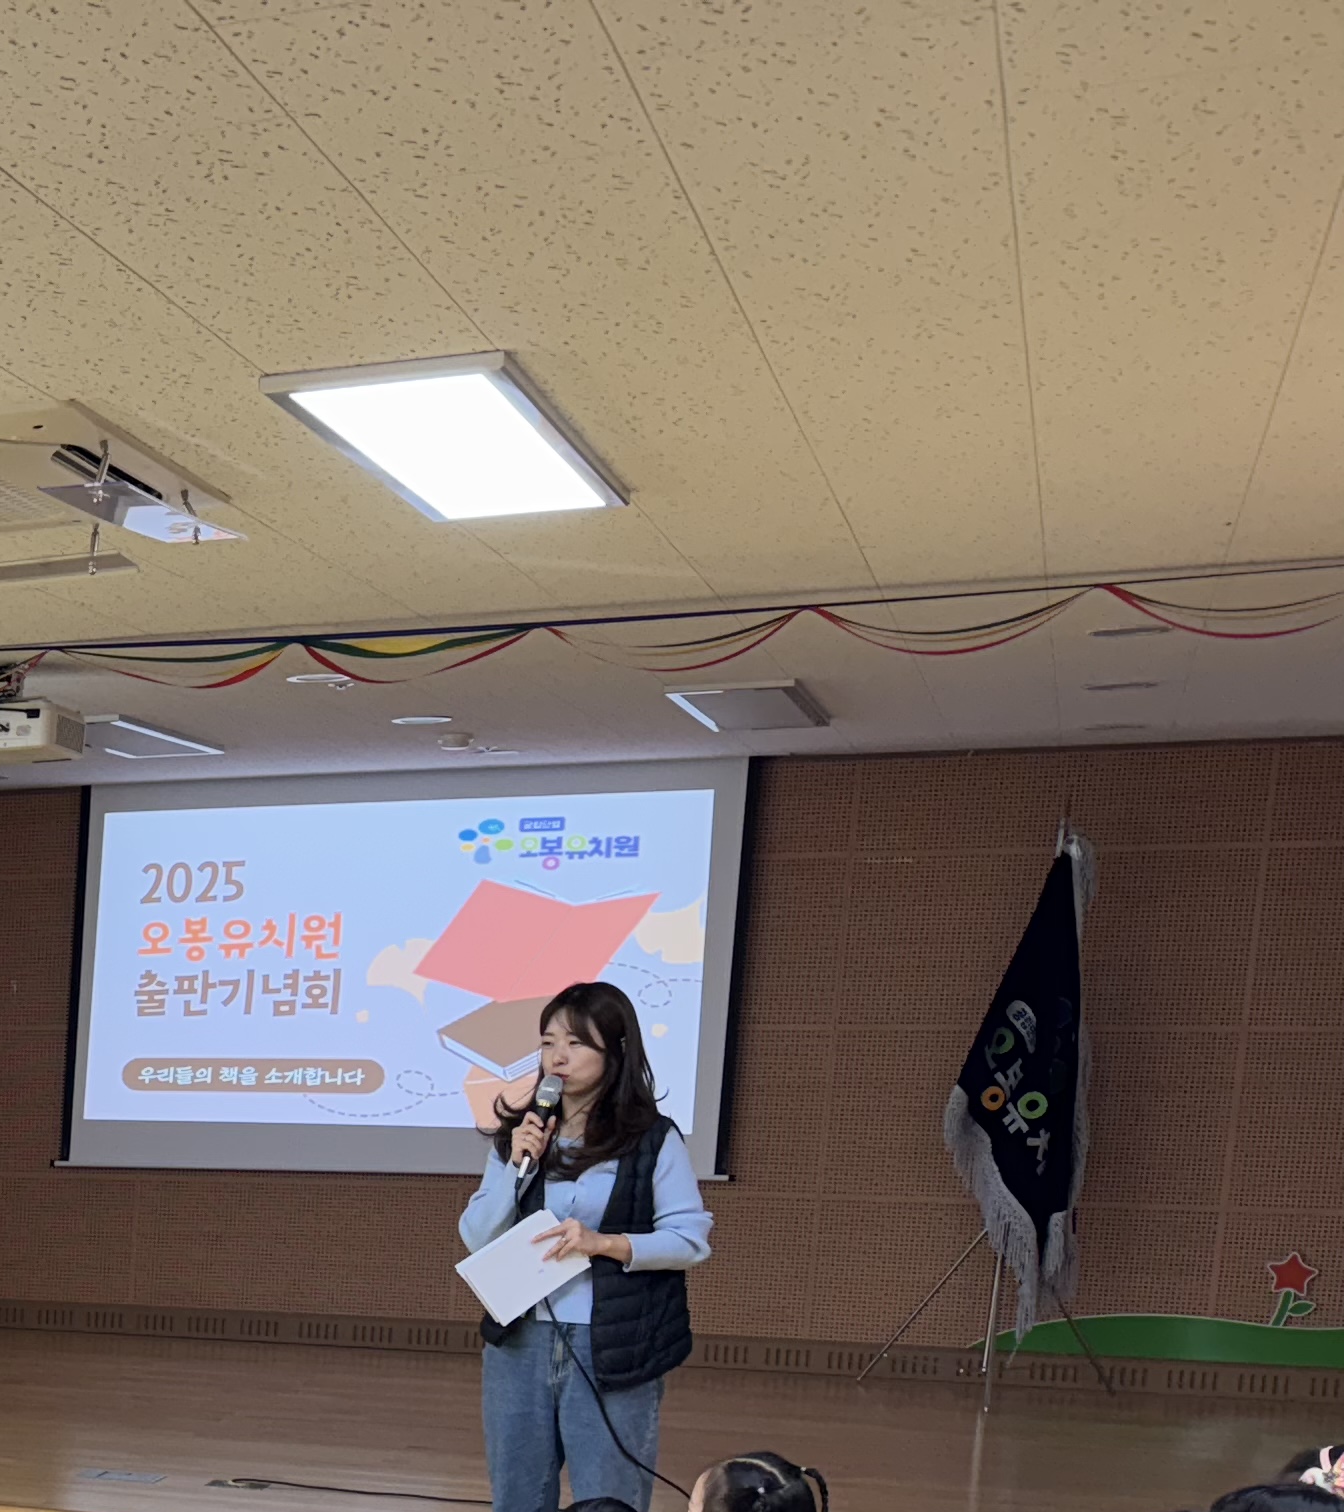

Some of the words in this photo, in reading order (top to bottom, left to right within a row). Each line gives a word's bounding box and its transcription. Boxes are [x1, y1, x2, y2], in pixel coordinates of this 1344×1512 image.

[519, 835, 640, 870] 오봉유치원
[140, 860, 246, 904] 2025
[137, 911, 342, 962] 오봉유치원
[134, 968, 342, 1016] 출판기념회
[138, 1066, 213, 1085] 우리들의
[219, 1066, 258, 1086] 책을
[264, 1067, 365, 1086] 소개합니다
[981, 1026, 1051, 1176] 오봉유치
